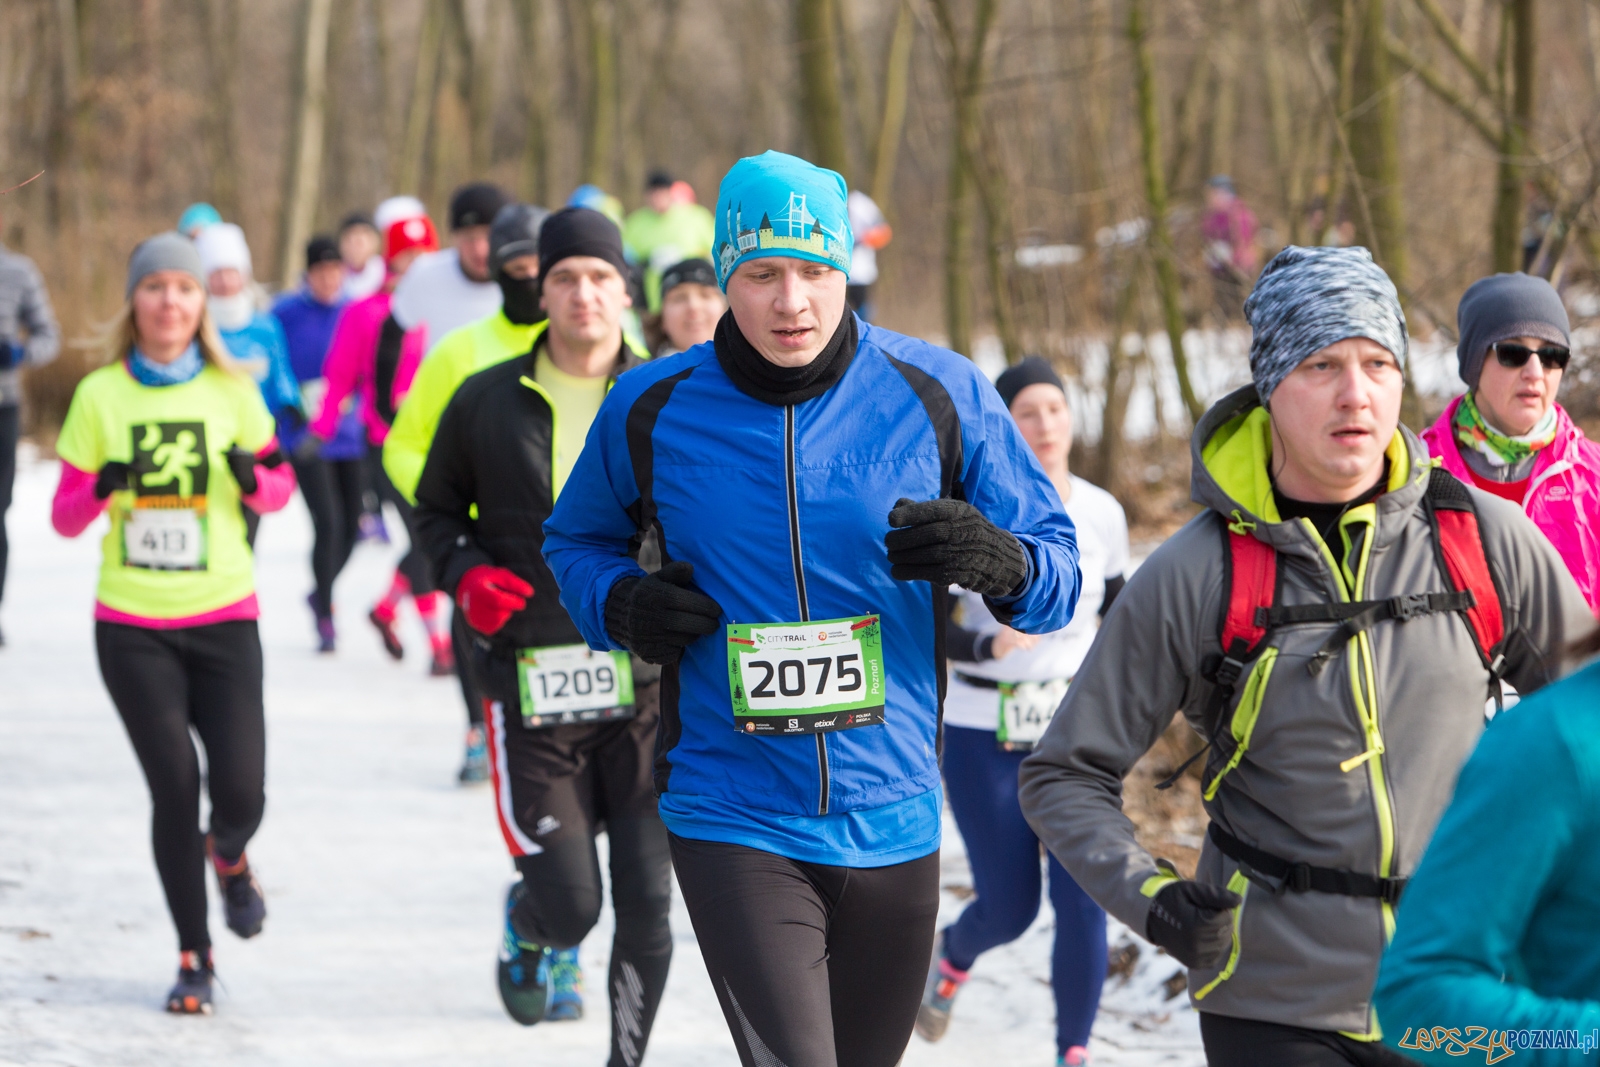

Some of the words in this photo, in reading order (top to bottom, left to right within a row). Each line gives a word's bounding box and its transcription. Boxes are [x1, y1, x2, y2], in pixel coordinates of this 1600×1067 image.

[537, 666, 614, 699] 1209
[748, 653, 862, 698] 2075
[868, 659, 880, 695] Poznań
